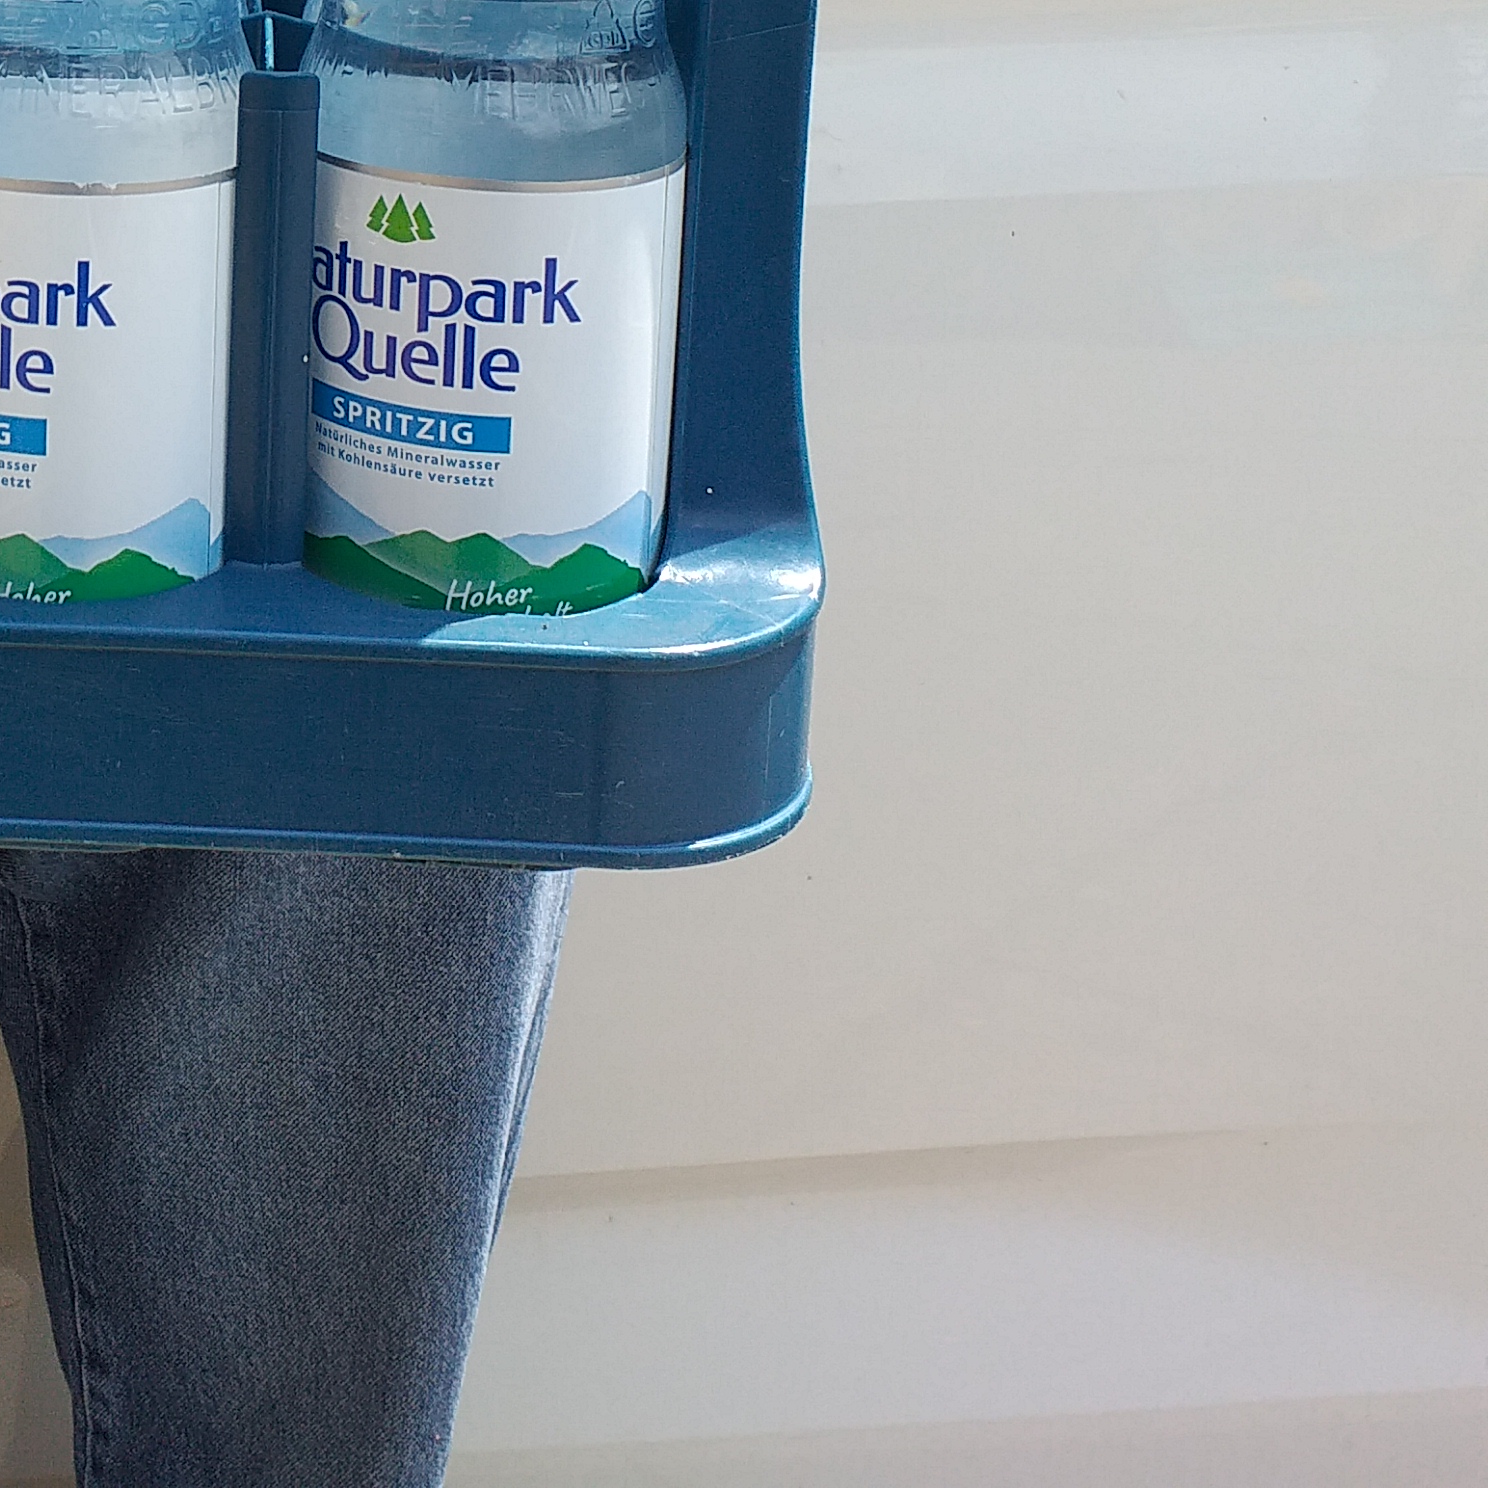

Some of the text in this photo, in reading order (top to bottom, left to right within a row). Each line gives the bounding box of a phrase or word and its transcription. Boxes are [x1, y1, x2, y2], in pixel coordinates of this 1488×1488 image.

[313, 294, 520, 392] Quelle
[333, 395, 474, 445] SPRITZIG
[315, 422, 500, 472] Natürliches Mineralwasser
[317, 439, 495, 488] mit Kohlensäure versetzt
[445, 578, 533, 611] Hoher
